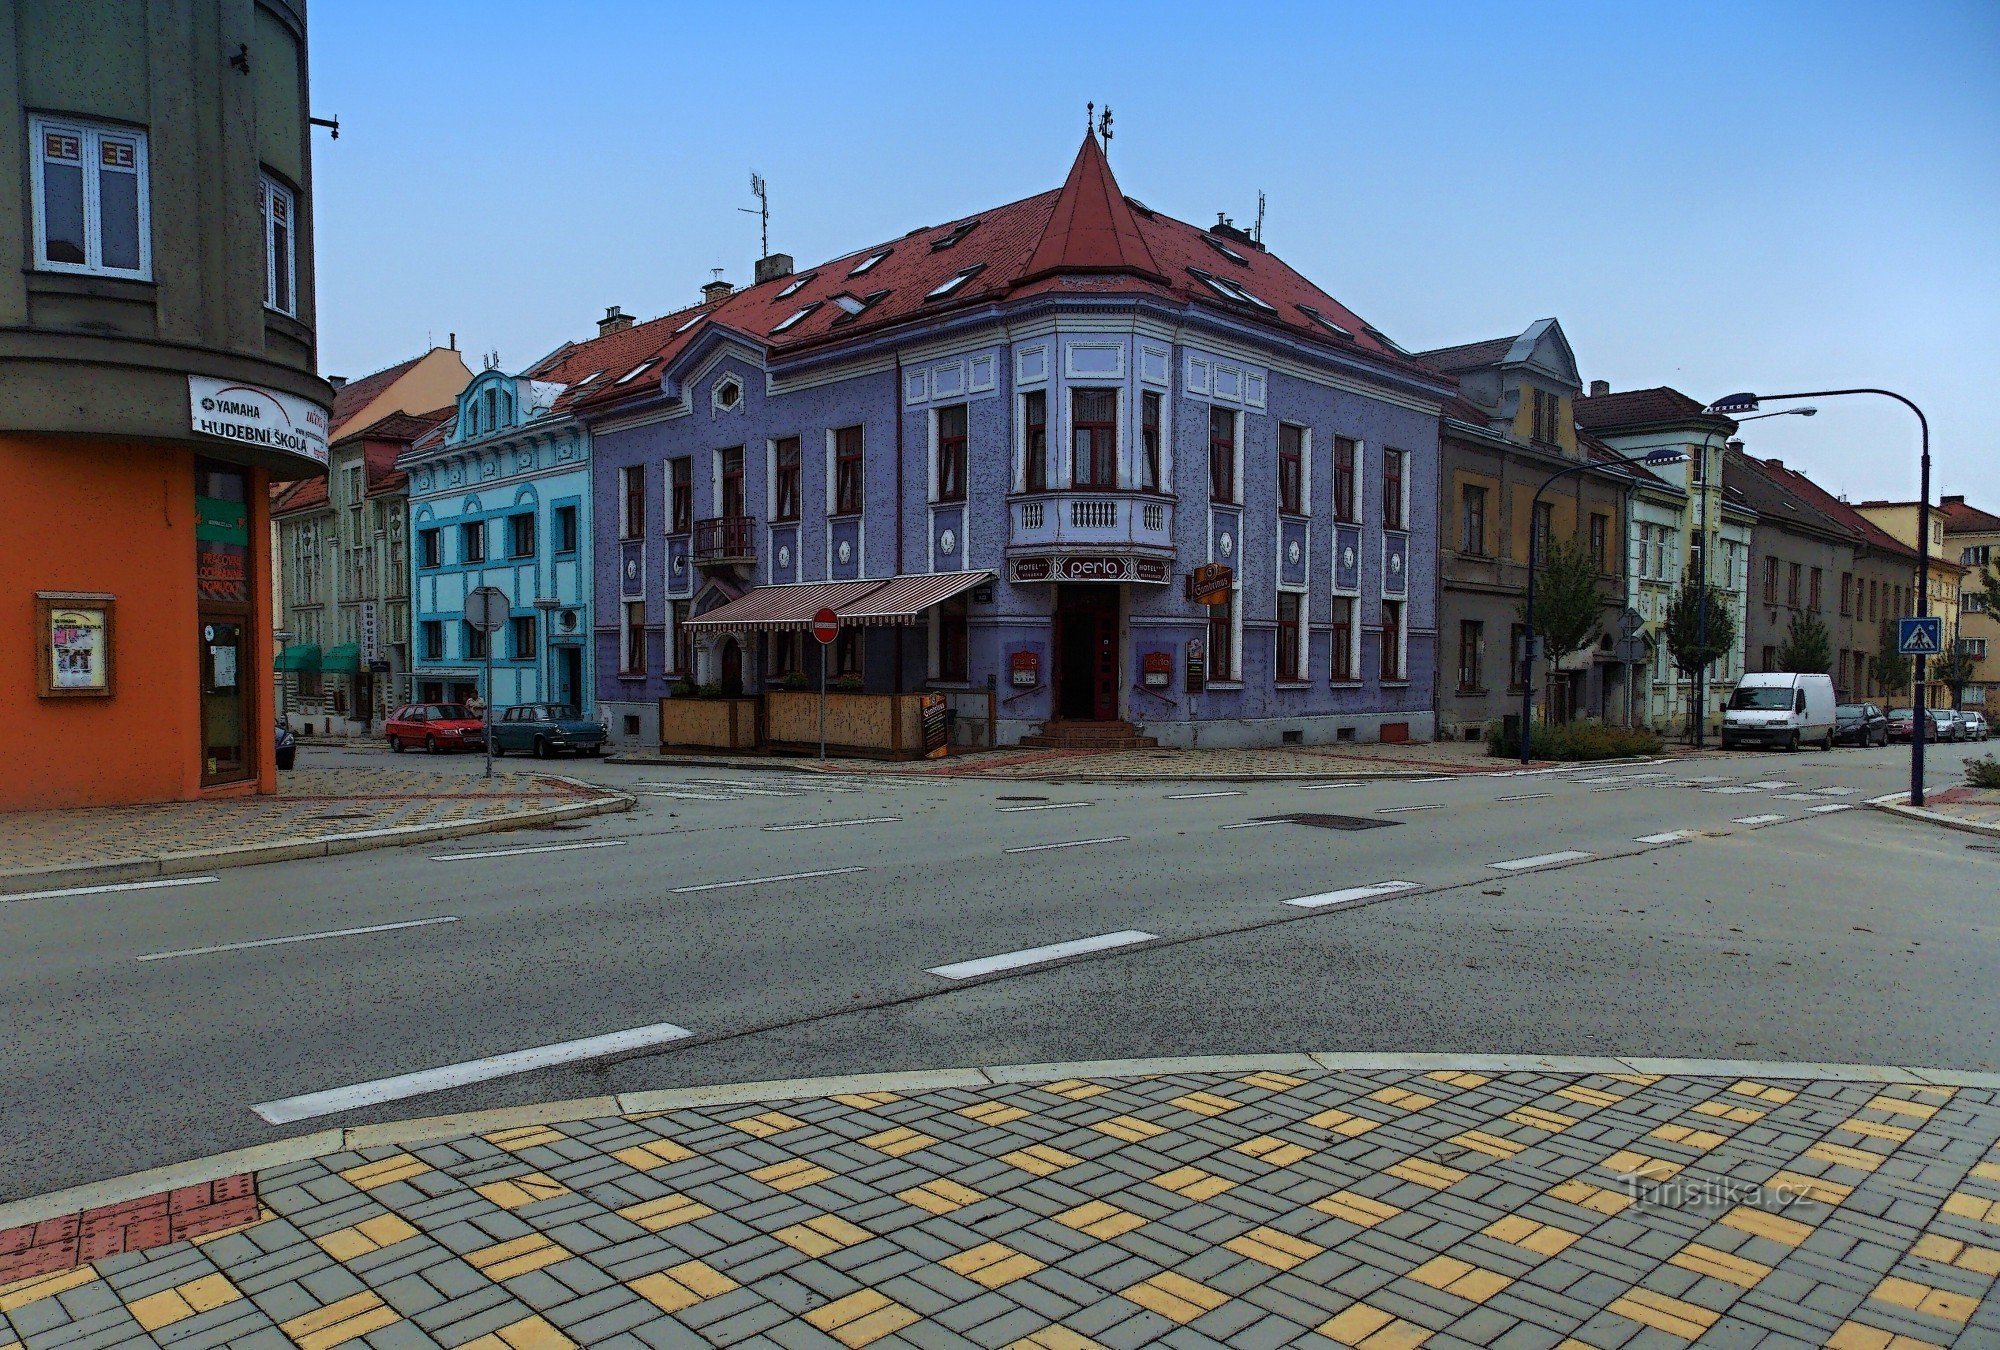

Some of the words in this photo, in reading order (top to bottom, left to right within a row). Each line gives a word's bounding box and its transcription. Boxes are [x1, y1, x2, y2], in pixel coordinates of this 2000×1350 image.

[216, 400, 260, 419] YAMAHA
[201, 420, 271, 443] HUDEBNÍ
[274, 428, 308, 453] ŠKOLA
[1070, 558, 1118, 578] perla
